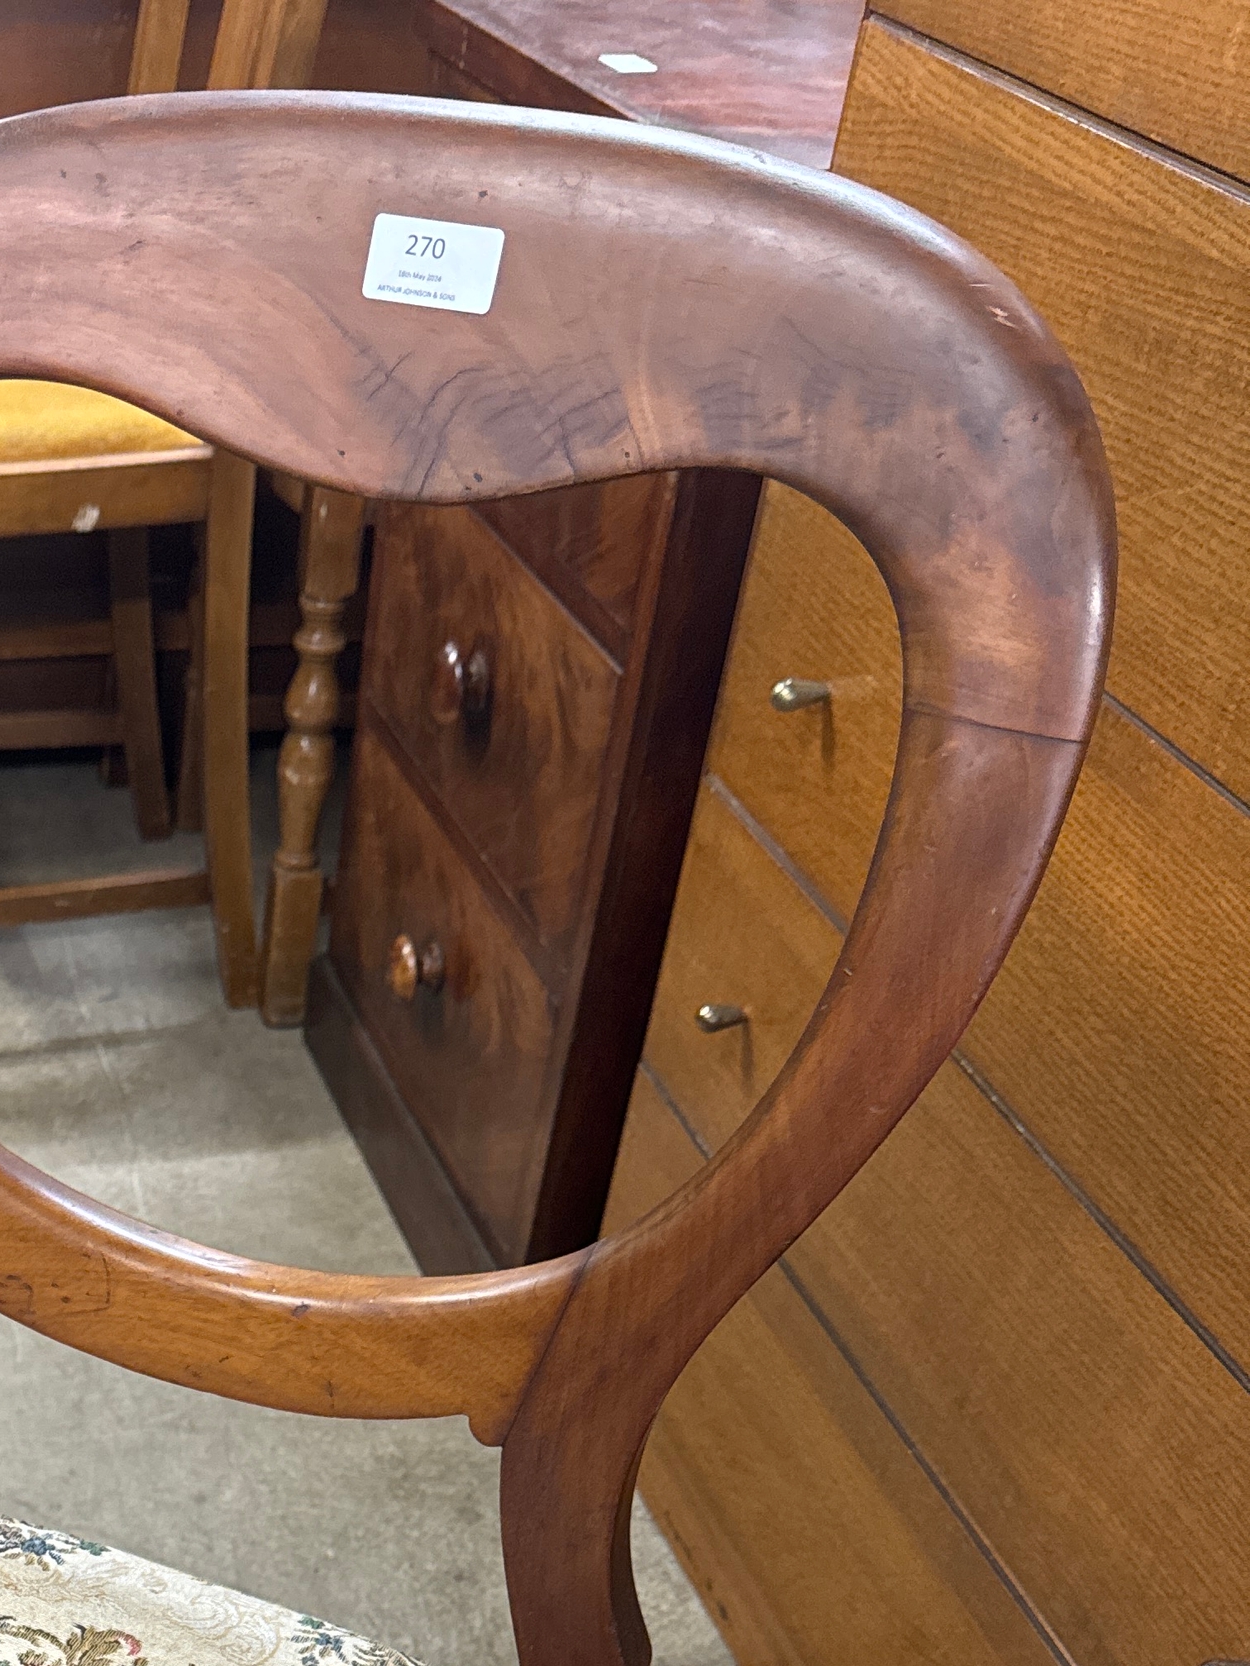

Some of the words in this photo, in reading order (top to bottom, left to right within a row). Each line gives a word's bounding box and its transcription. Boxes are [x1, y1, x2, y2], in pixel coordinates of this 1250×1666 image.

[405, 234, 446, 259] 270
[413, 272, 426, 281] May
[377, 284, 402, 293] ARTHUR
[403, 288, 432, 298] JOHNSON
[439, 292, 456, 301] SONS
